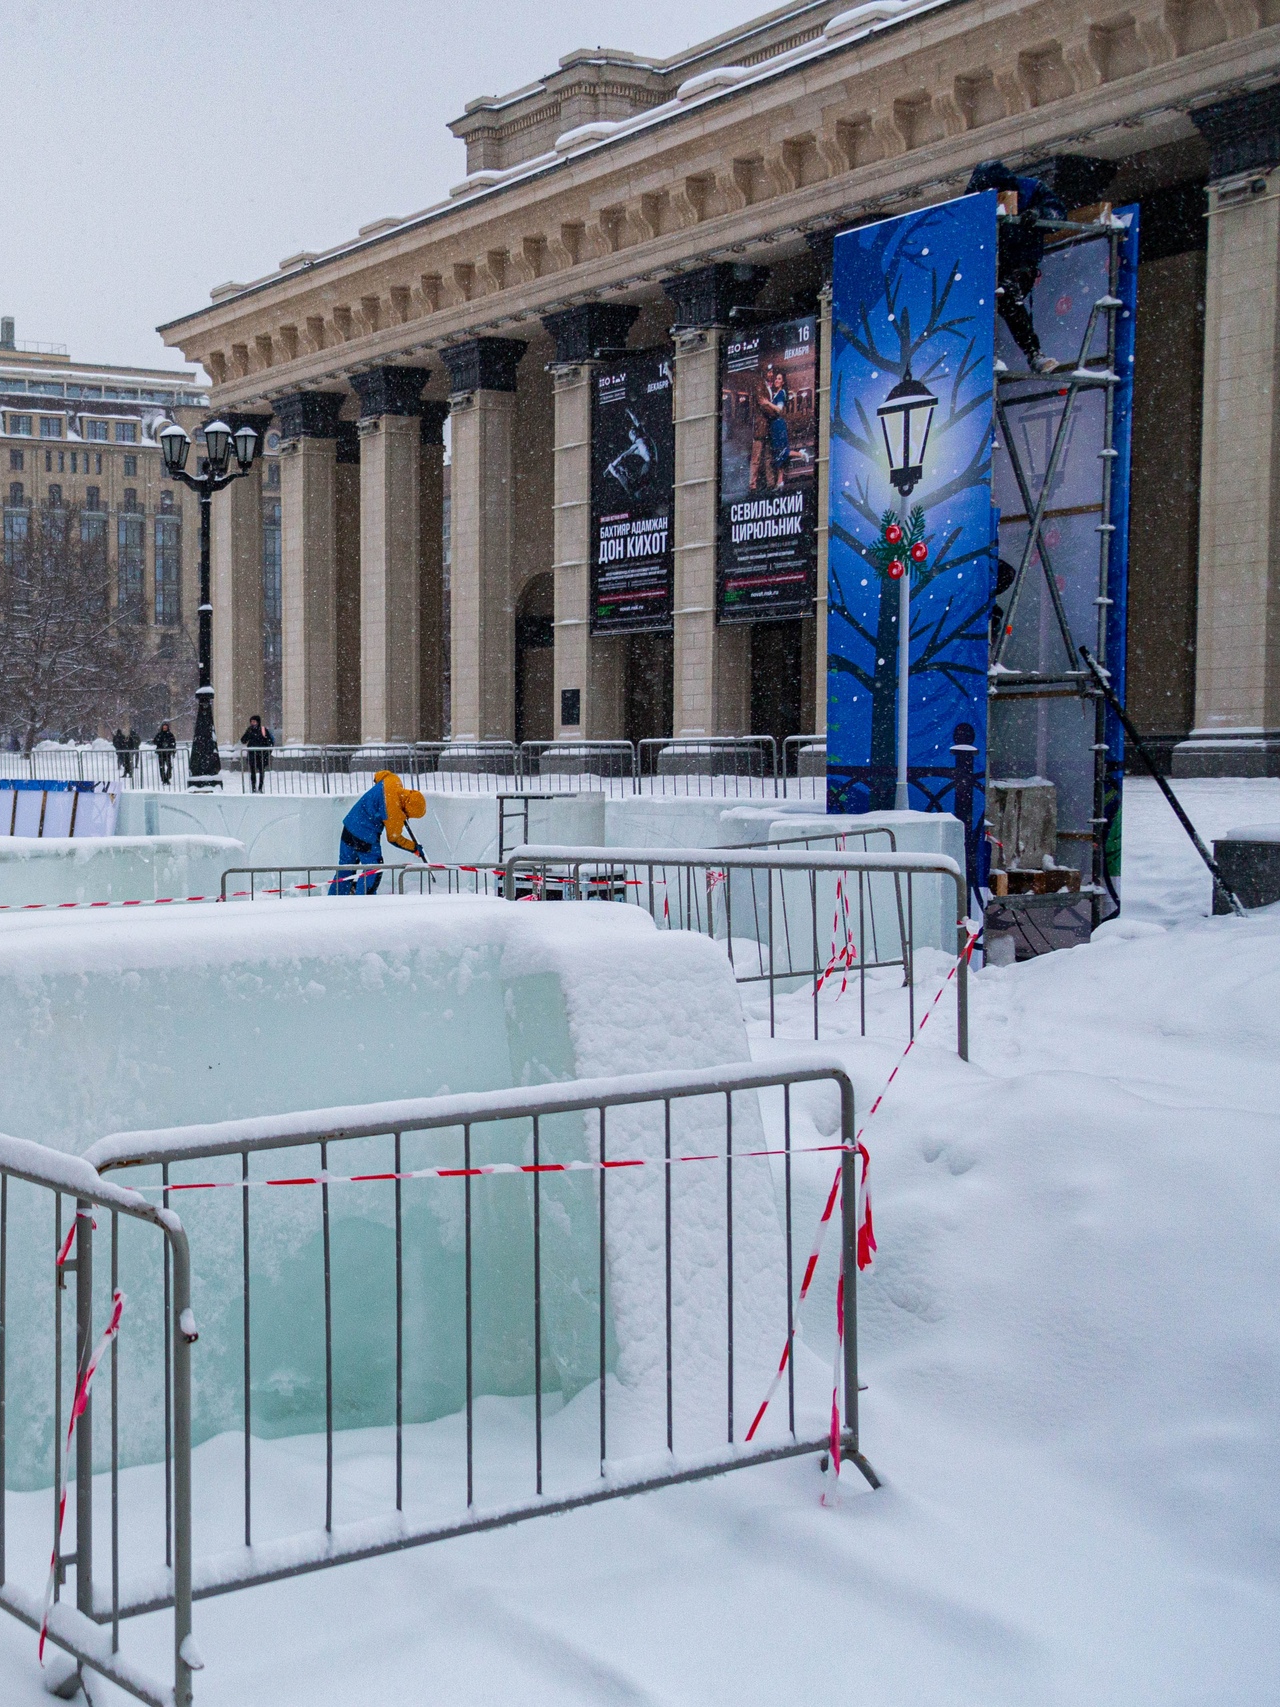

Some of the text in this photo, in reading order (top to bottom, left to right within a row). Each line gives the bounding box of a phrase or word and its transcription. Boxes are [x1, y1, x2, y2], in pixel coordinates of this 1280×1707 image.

[798, 325, 810, 342] 16
[784, 345, 810, 360] ДЕКАБРЯ
[658, 361, 670, 377] 14
[647, 380, 669, 393] ДЕКАБРЯ
[730, 490, 803, 523] СЕВИЛЬСКИЙ
[600, 522, 631, 539] БАХТИЯР
[631, 516, 668, 535] АДАМЖАН
[731, 516, 802, 544] ЦИРЮЛЬНИК
[598, 531, 669, 564] ДОН КИХОТ
